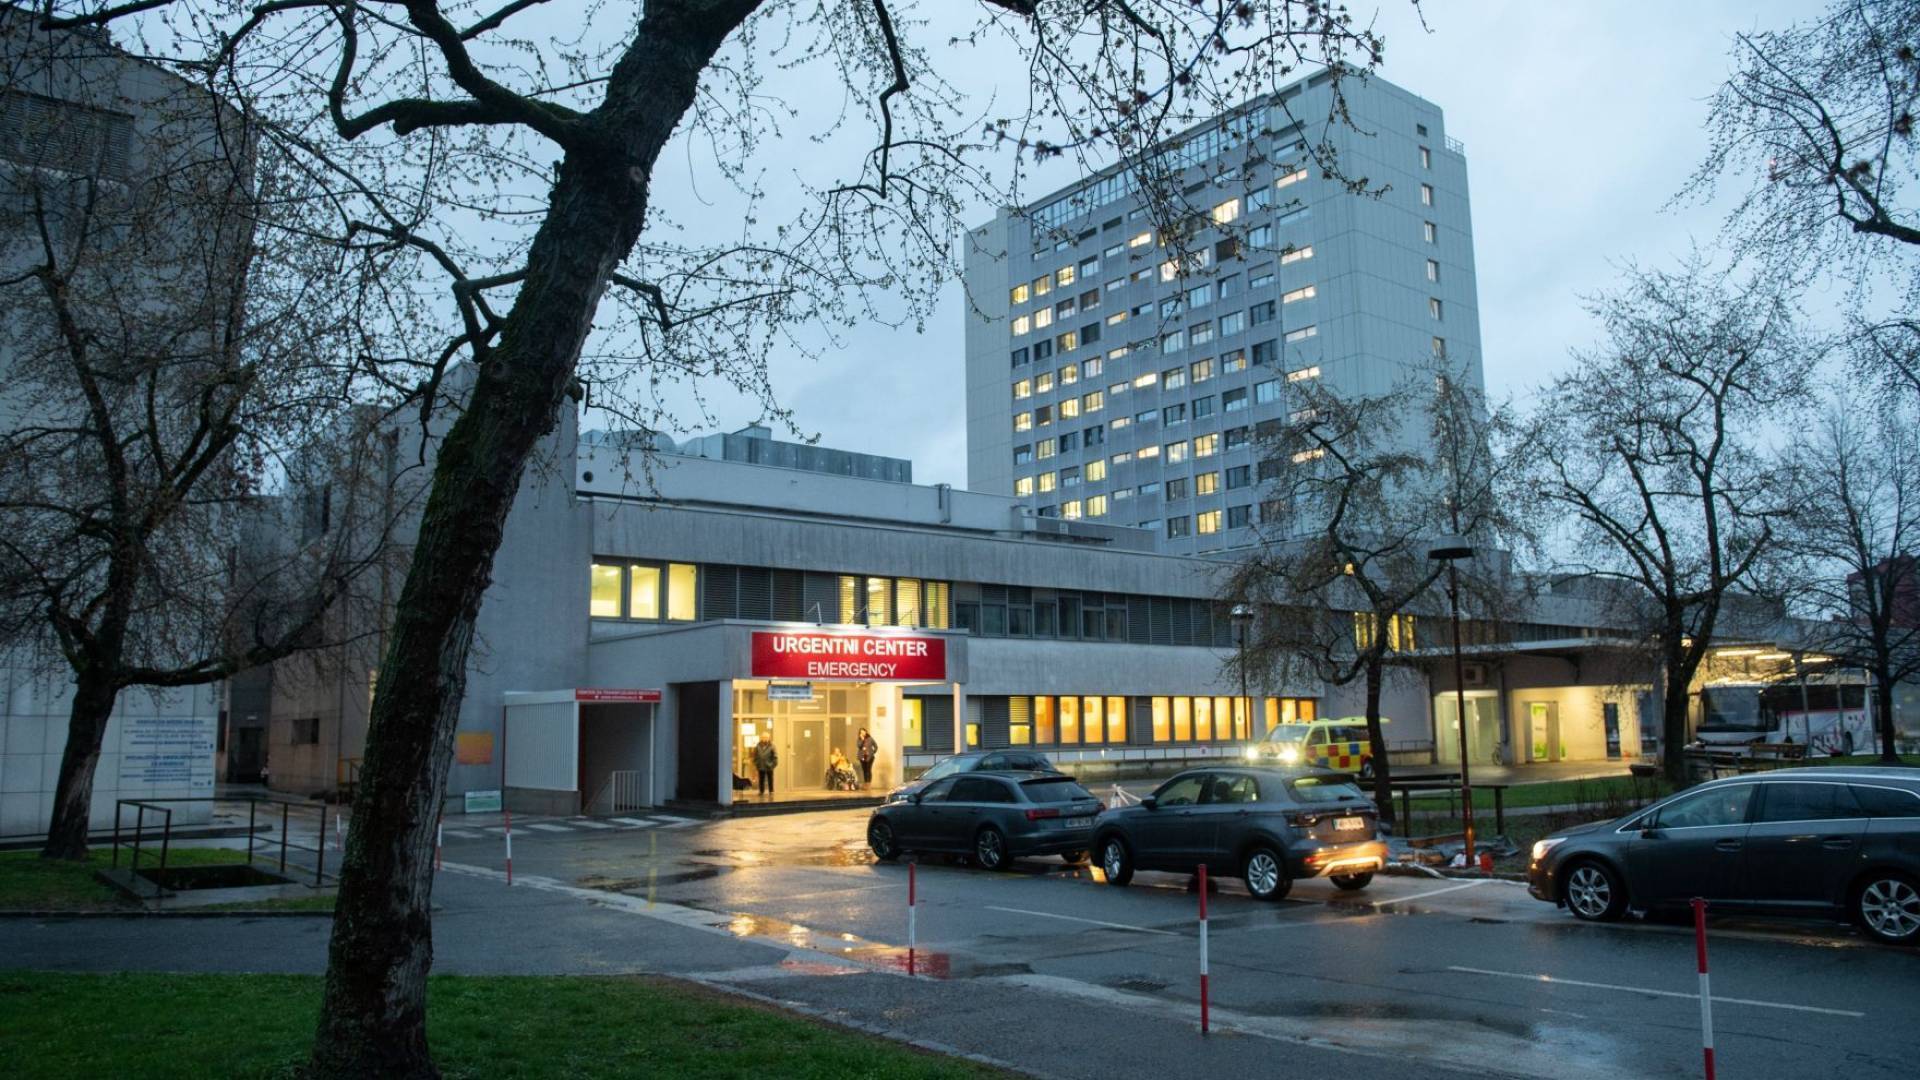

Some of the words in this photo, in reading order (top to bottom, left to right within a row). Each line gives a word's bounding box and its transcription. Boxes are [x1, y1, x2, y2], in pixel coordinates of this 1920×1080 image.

[773, 636, 859, 655] URGENTNI
[863, 639, 928, 657] CENTER
[807, 661, 897, 677] EMERGENCY
